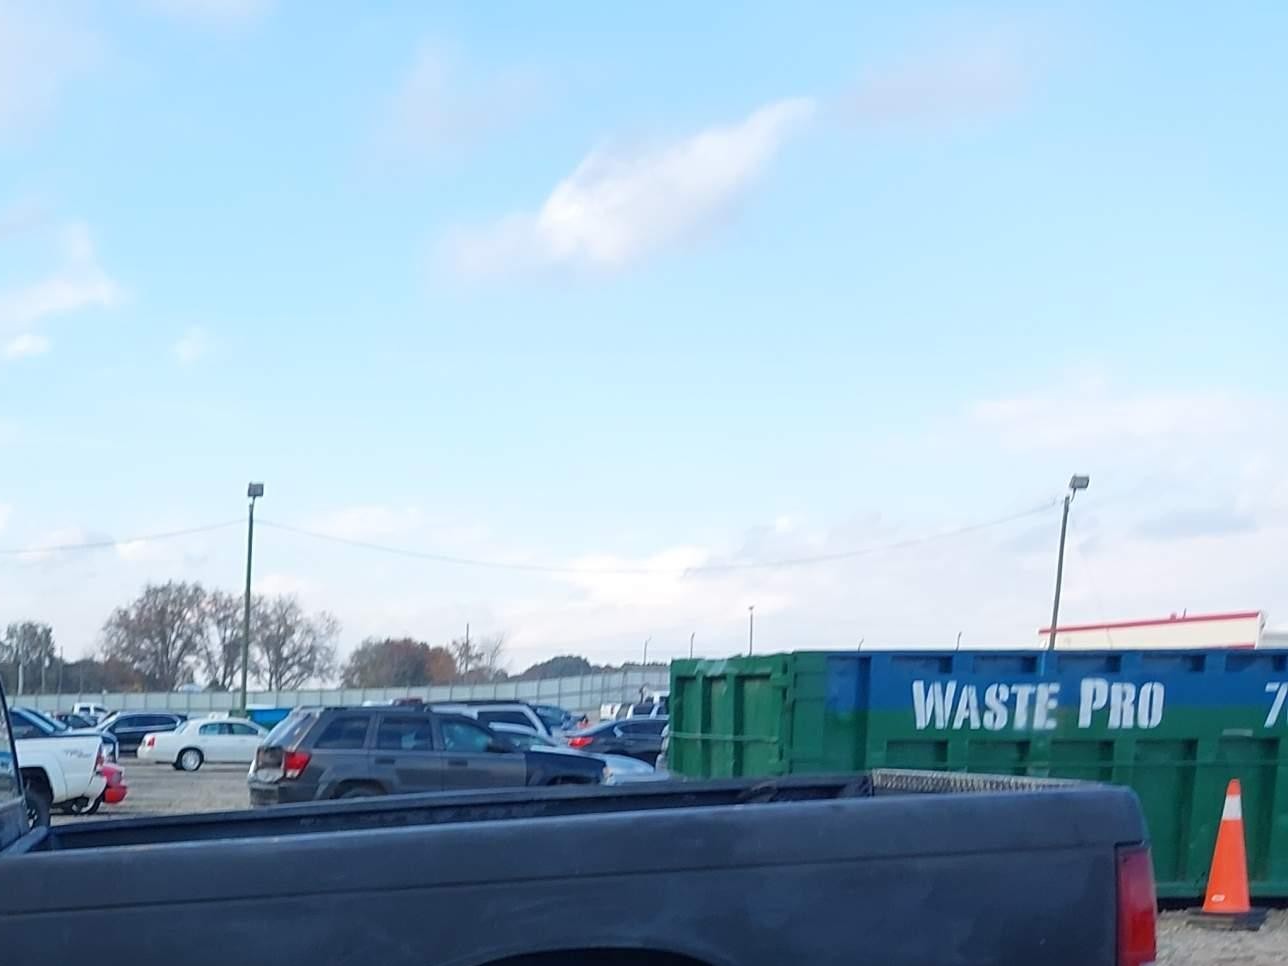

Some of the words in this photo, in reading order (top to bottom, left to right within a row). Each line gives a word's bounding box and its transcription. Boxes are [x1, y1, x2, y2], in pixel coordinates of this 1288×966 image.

[911, 680, 1060, 730] WASTE
[1078, 678, 1165, 729] PRO
[1263, 681, 1288, 728] 7
